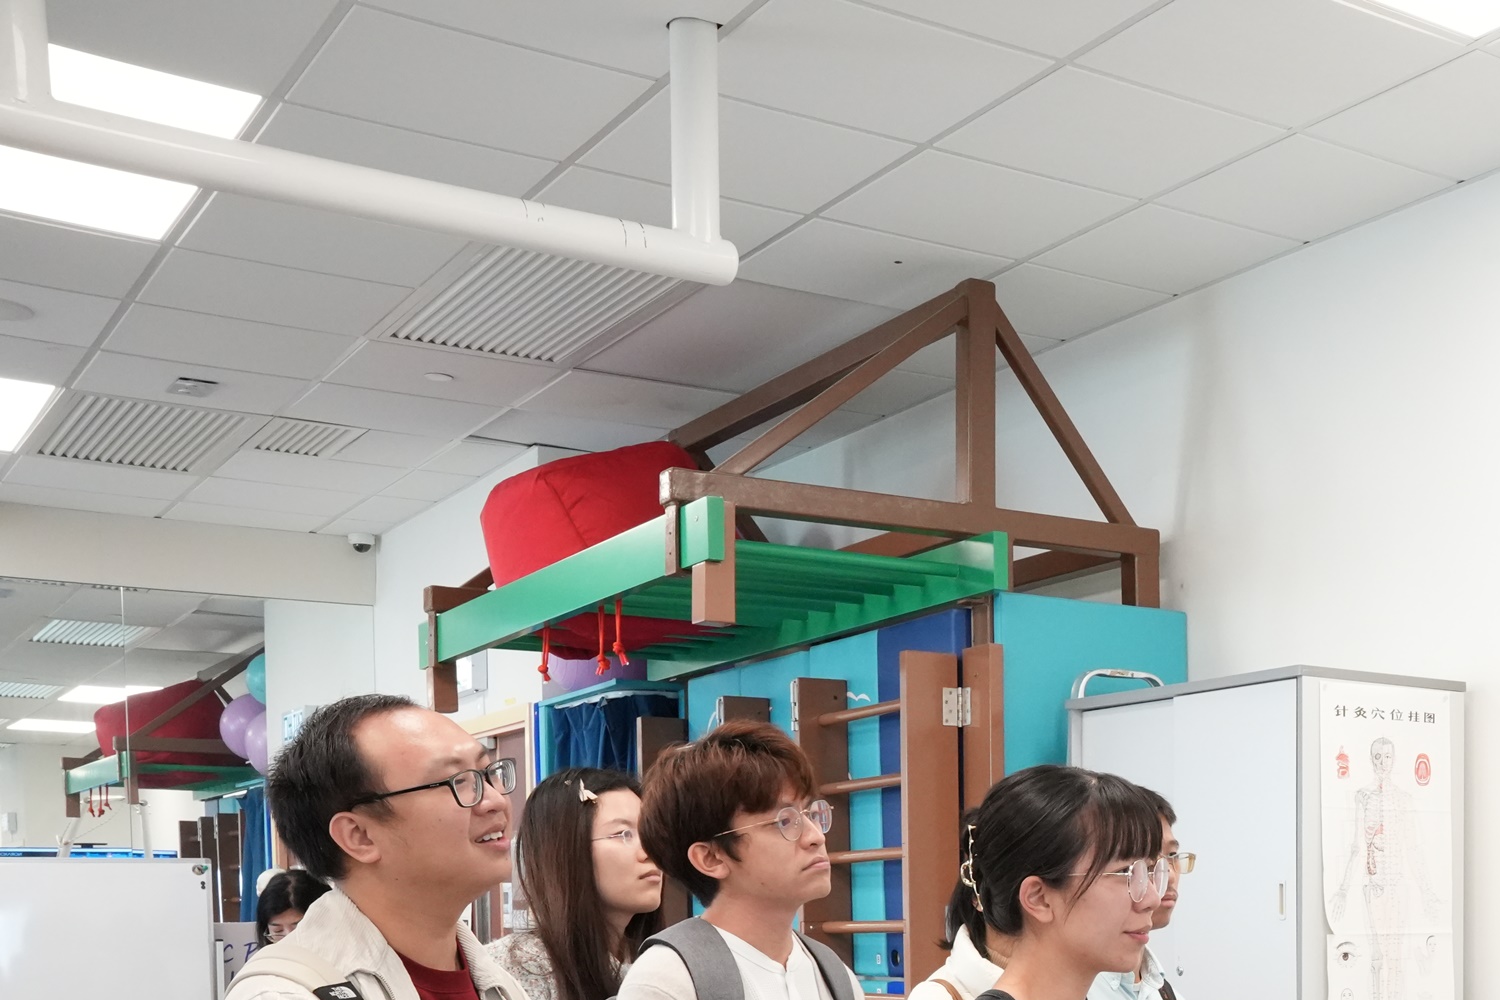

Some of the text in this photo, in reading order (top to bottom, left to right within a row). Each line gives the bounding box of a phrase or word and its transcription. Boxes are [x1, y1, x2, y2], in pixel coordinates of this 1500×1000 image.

[1334, 704, 1436, 724] 针灸穴位挂图
